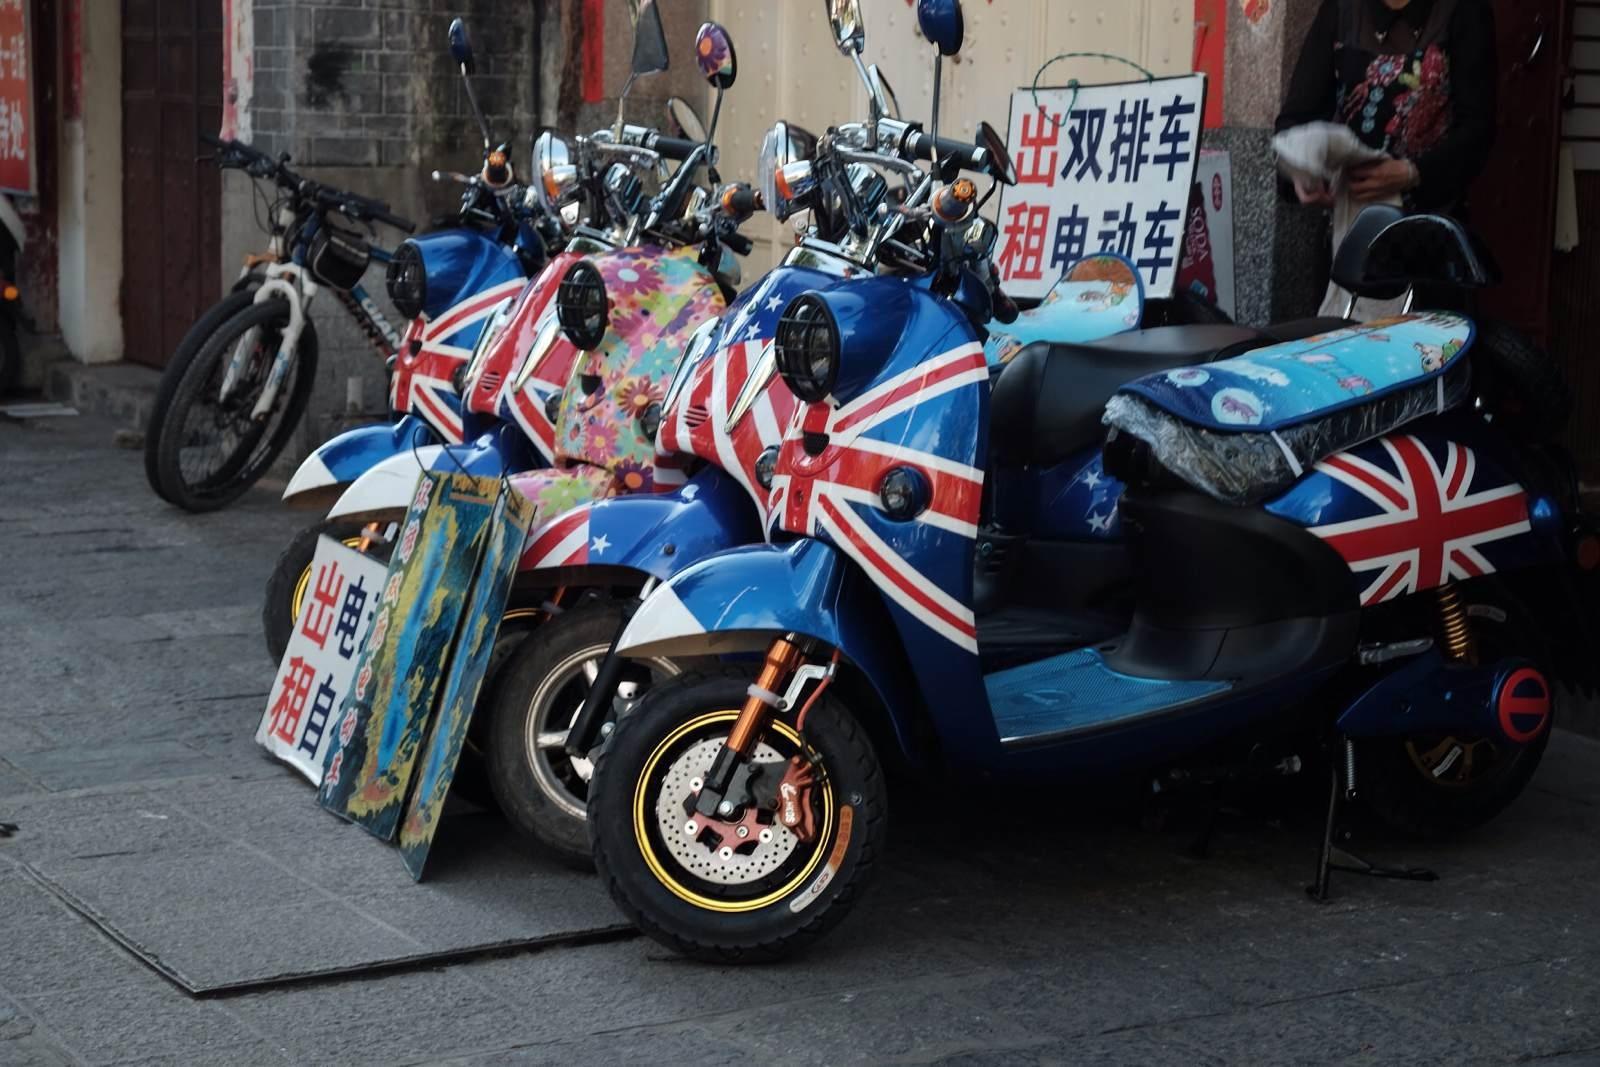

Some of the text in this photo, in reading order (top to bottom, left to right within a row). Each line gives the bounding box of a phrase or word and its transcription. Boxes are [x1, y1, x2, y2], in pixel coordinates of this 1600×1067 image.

[1060, 94, 1195, 184] 双排车
[1050, 200, 1181, 285] 电动车
[1191, 207, 1209, 262] SODA
[267, 560, 344, 746] 出租
